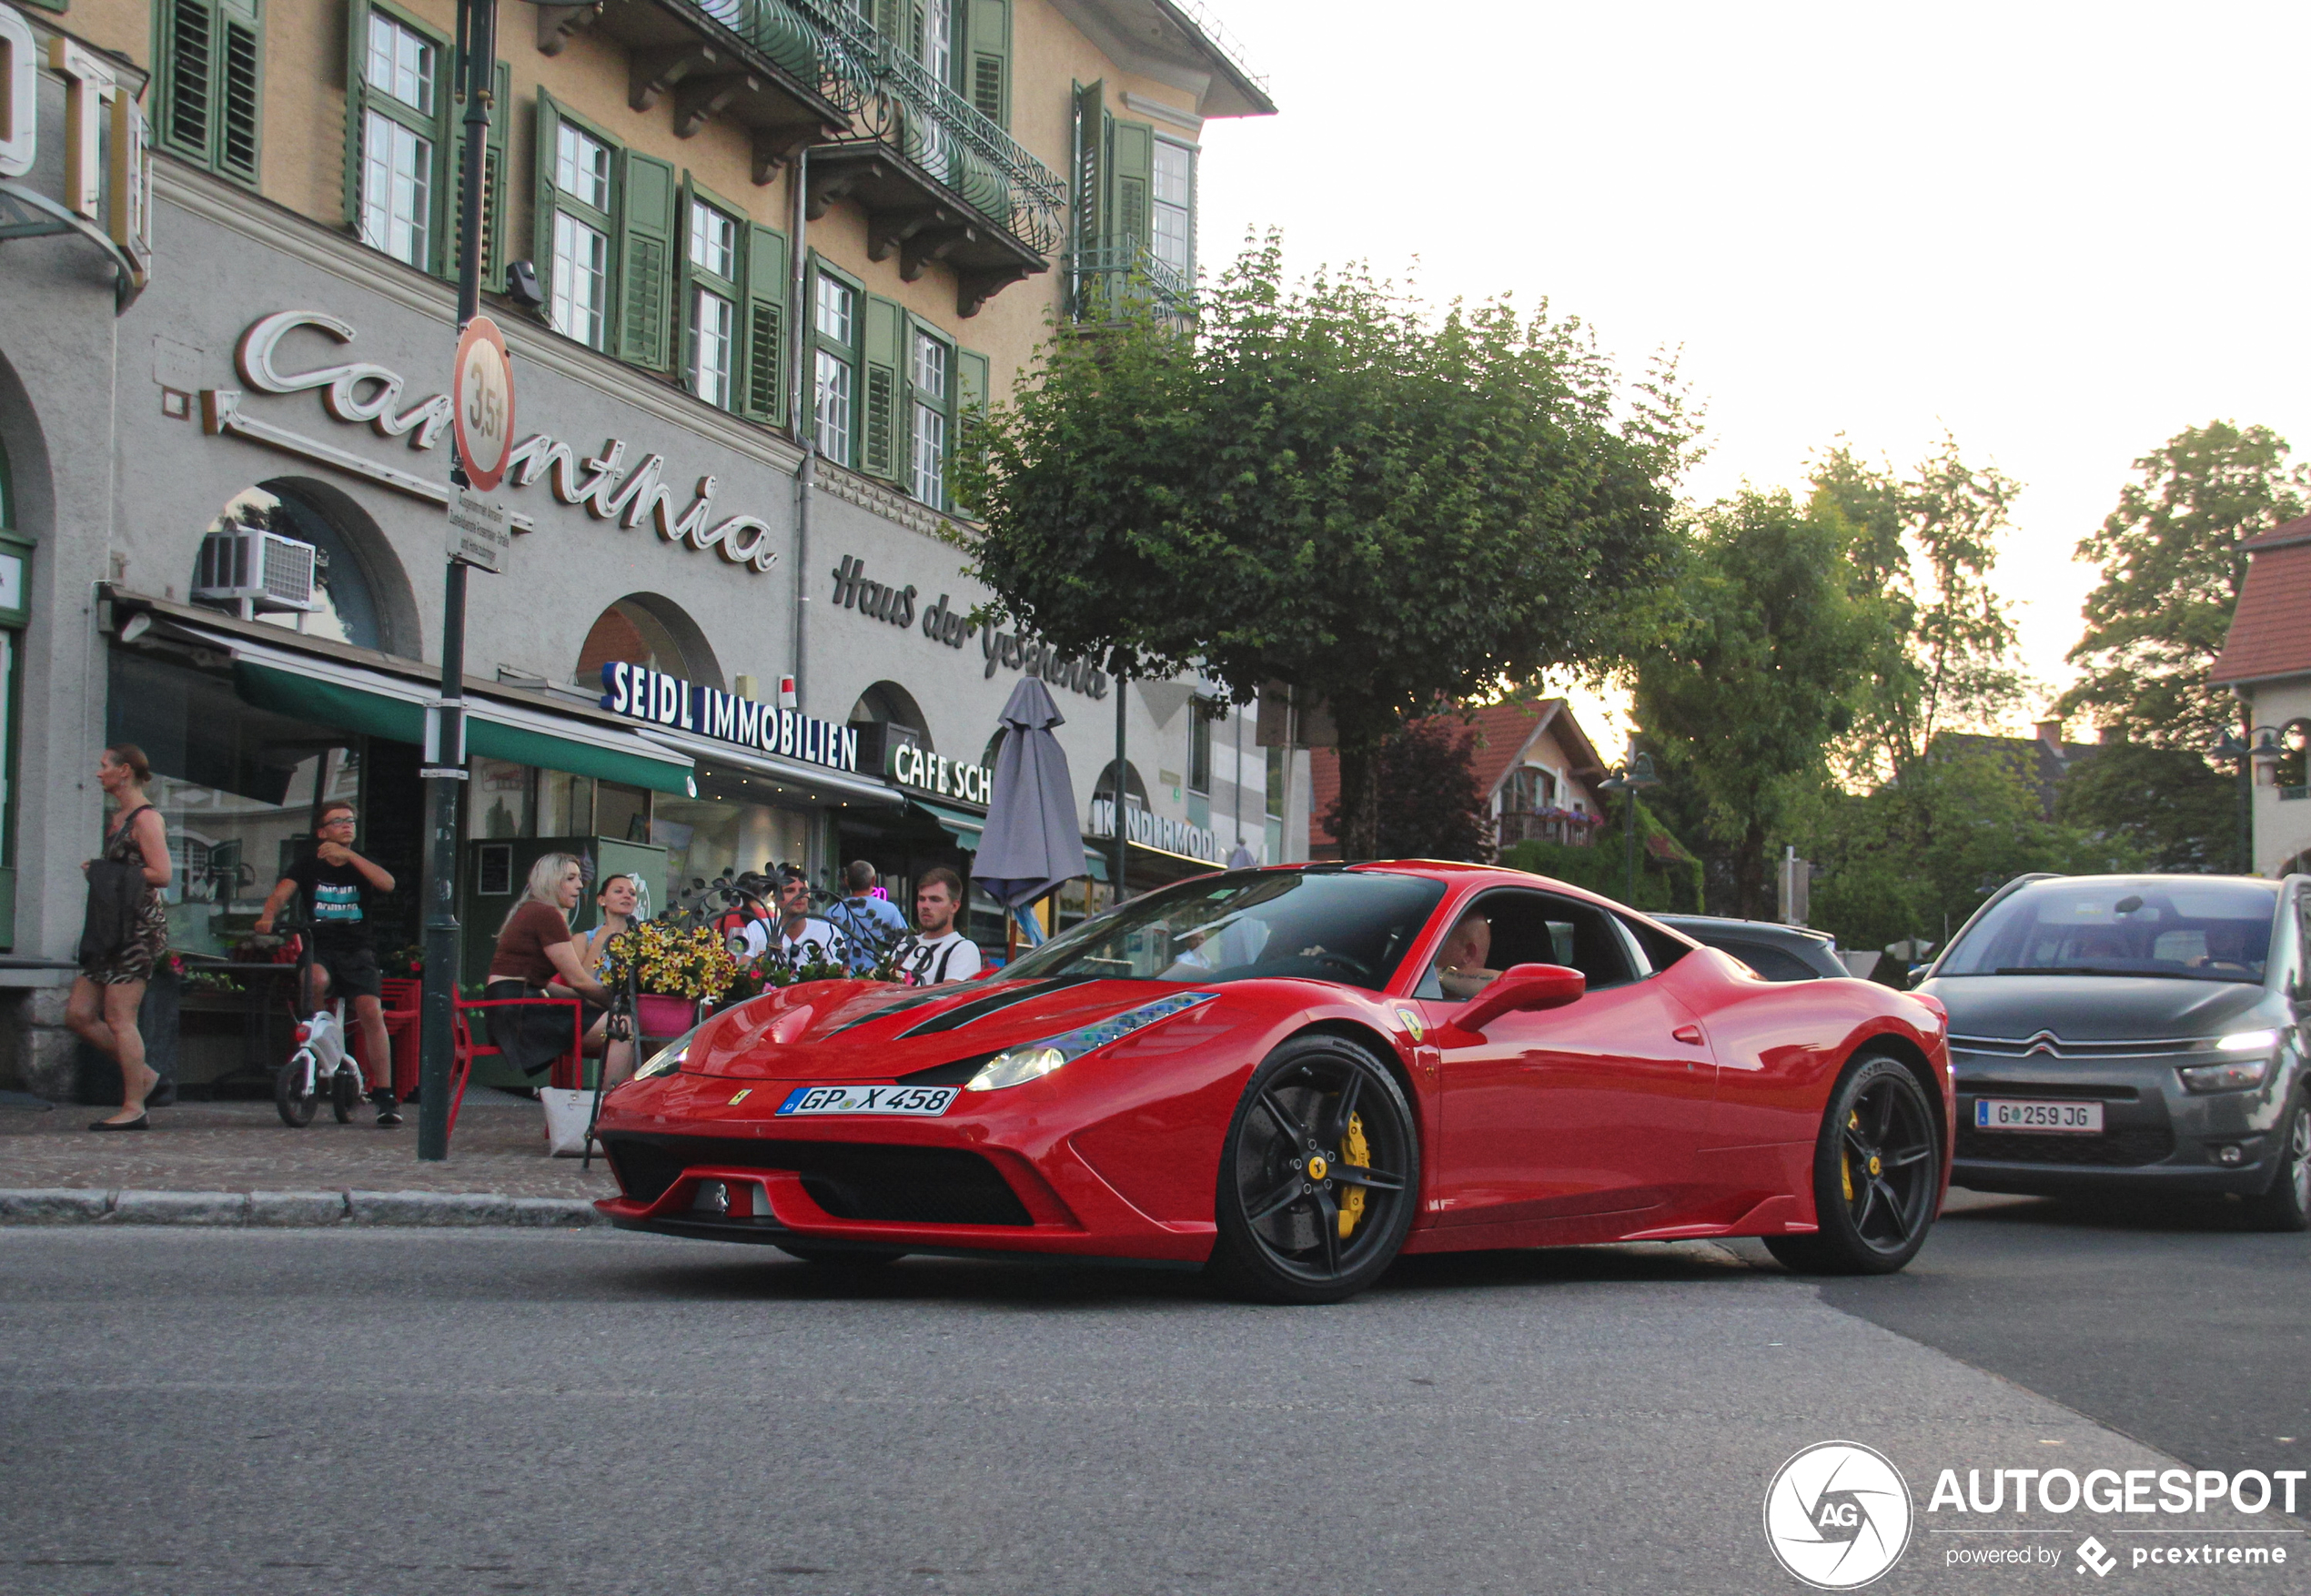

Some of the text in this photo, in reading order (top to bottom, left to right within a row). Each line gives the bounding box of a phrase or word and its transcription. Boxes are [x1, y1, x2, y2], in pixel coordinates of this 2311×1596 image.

[235, 310, 778, 573] Carnthia
[833, 554, 918, 629] Haus
[923, 593, 978, 650] der
[604, 662, 858, 773] SEIDL IMMOBILIEN
[954, 761, 993, 805] SCH
[1099, 797, 1227, 865] KNDERMOD
[800, 1089, 848, 1109] GP
[857, 1088, 886, 1108] X
[885, 1089, 951, 1111] 458
[1998, 1105, 2009, 1124] G
[2023, 1106, 2059, 1126] 259
[2064, 1106, 2087, 1126] JG
